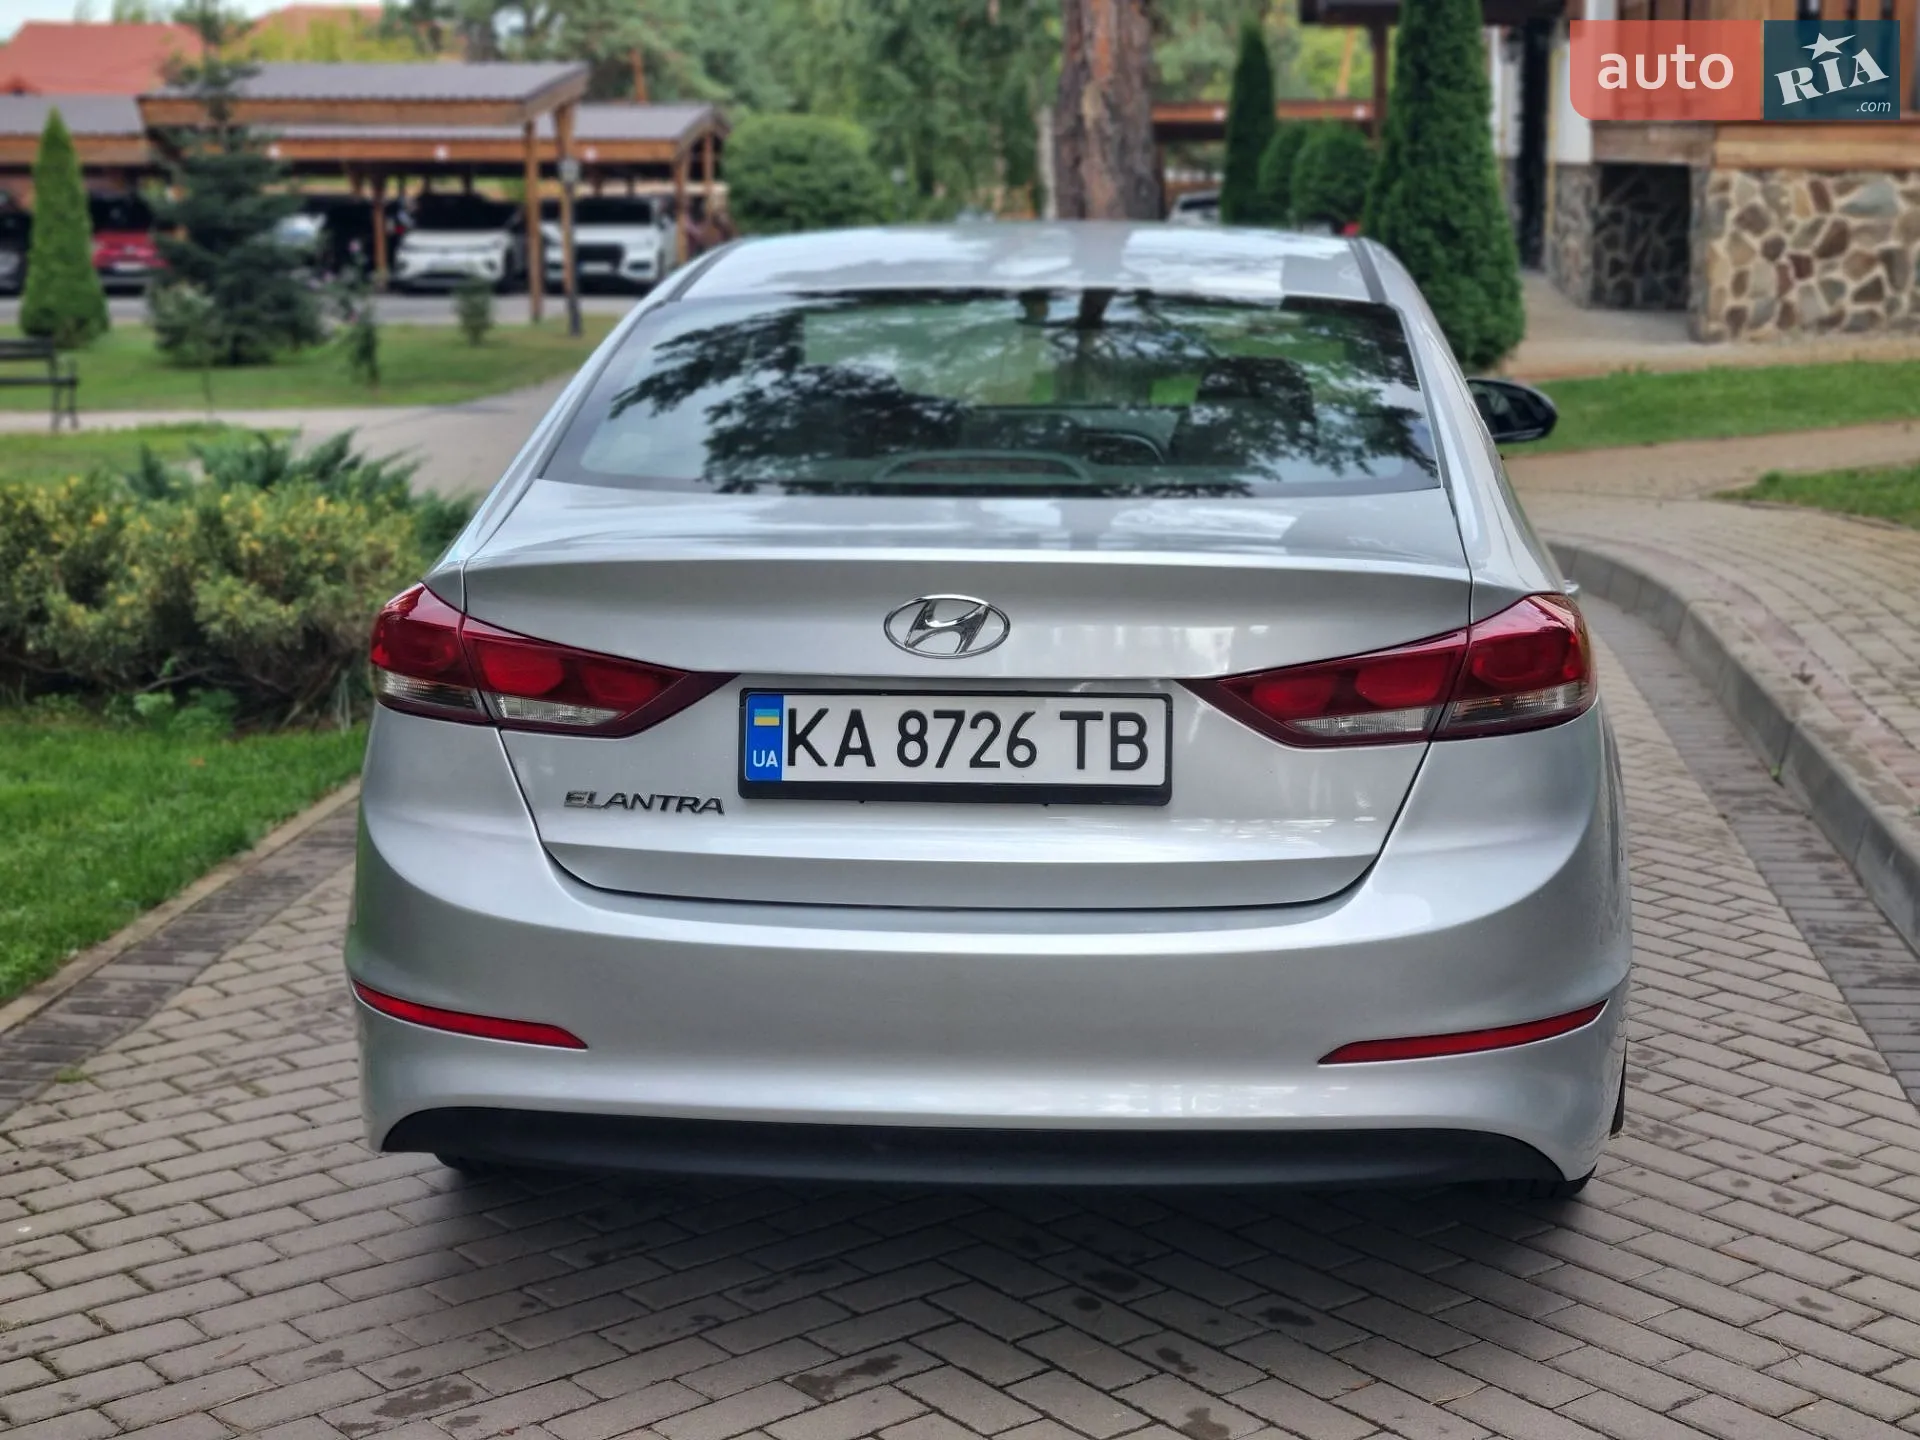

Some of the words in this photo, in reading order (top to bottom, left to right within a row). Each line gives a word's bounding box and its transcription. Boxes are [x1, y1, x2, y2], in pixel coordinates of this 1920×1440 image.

[787, 708, 876, 768] KA
[896, 710, 1038, 769] 8726
[1059, 711, 1150, 771] TB
[752, 750, 779, 768] UA
[564, 791, 726, 815] ELANTRA
